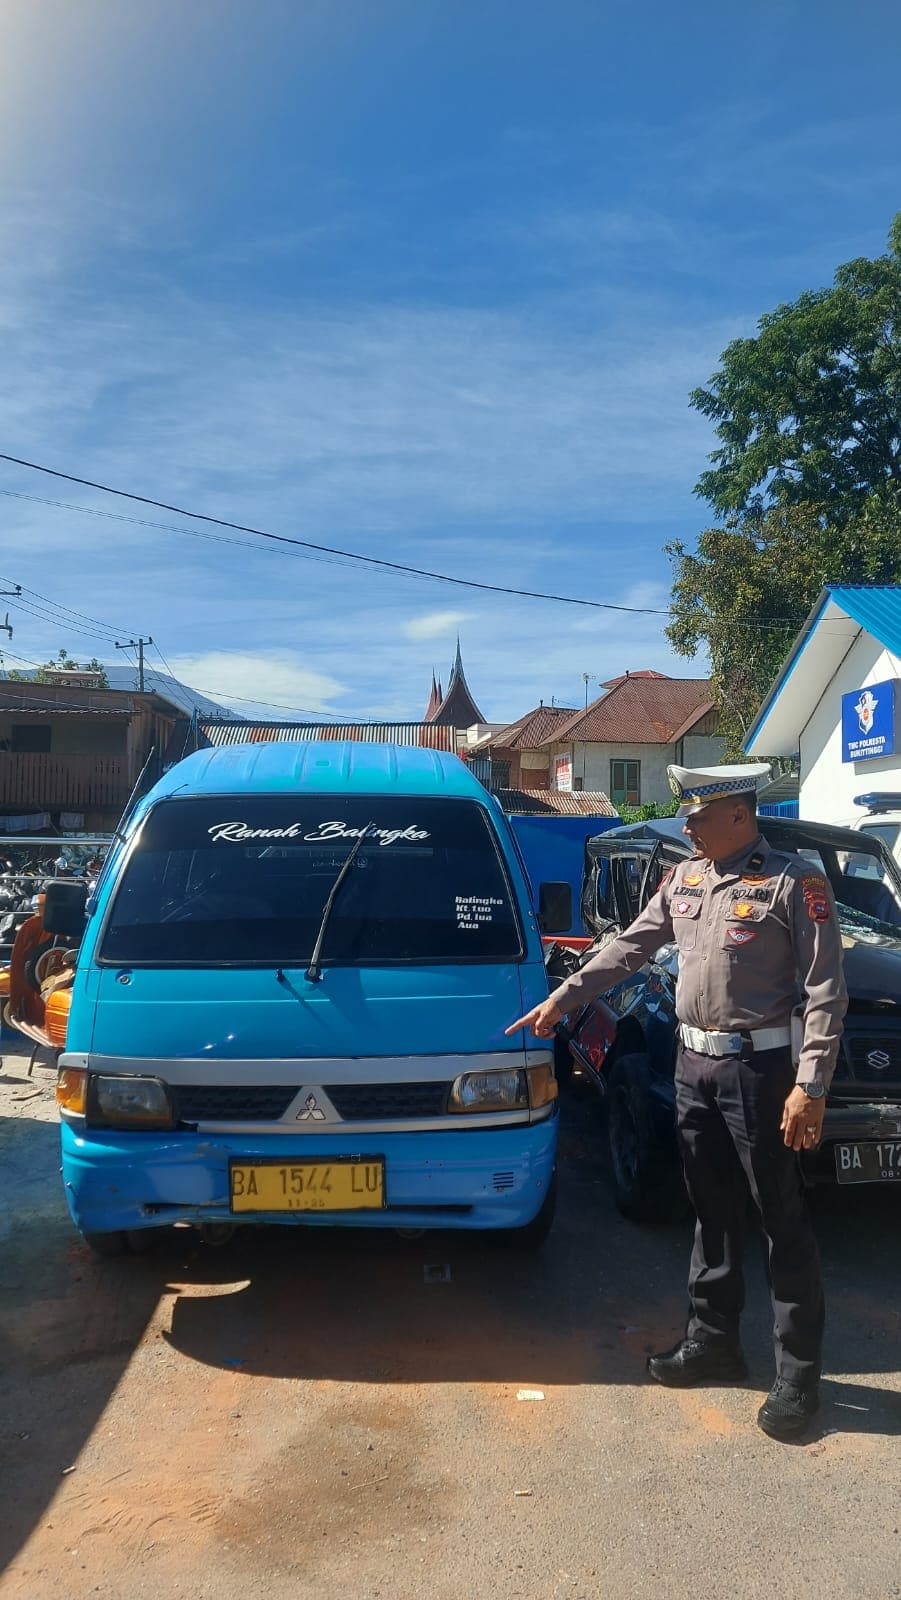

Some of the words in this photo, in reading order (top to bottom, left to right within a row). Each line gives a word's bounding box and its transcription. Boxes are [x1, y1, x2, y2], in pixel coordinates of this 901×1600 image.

[860, 736, 886, 747] POLRESTA
[850, 745, 883, 757] BUKITTINGGI
[208, 822, 302, 842] Ranah
[456, 912, 473, 921] Pd.
[457, 921, 479, 929] Aua
[840, 1145, 862, 1169] BA
[232, 1169, 258, 1196] BA
[279, 1167, 333, 1195] 1544
[351, 1166, 379, 1193] LU
